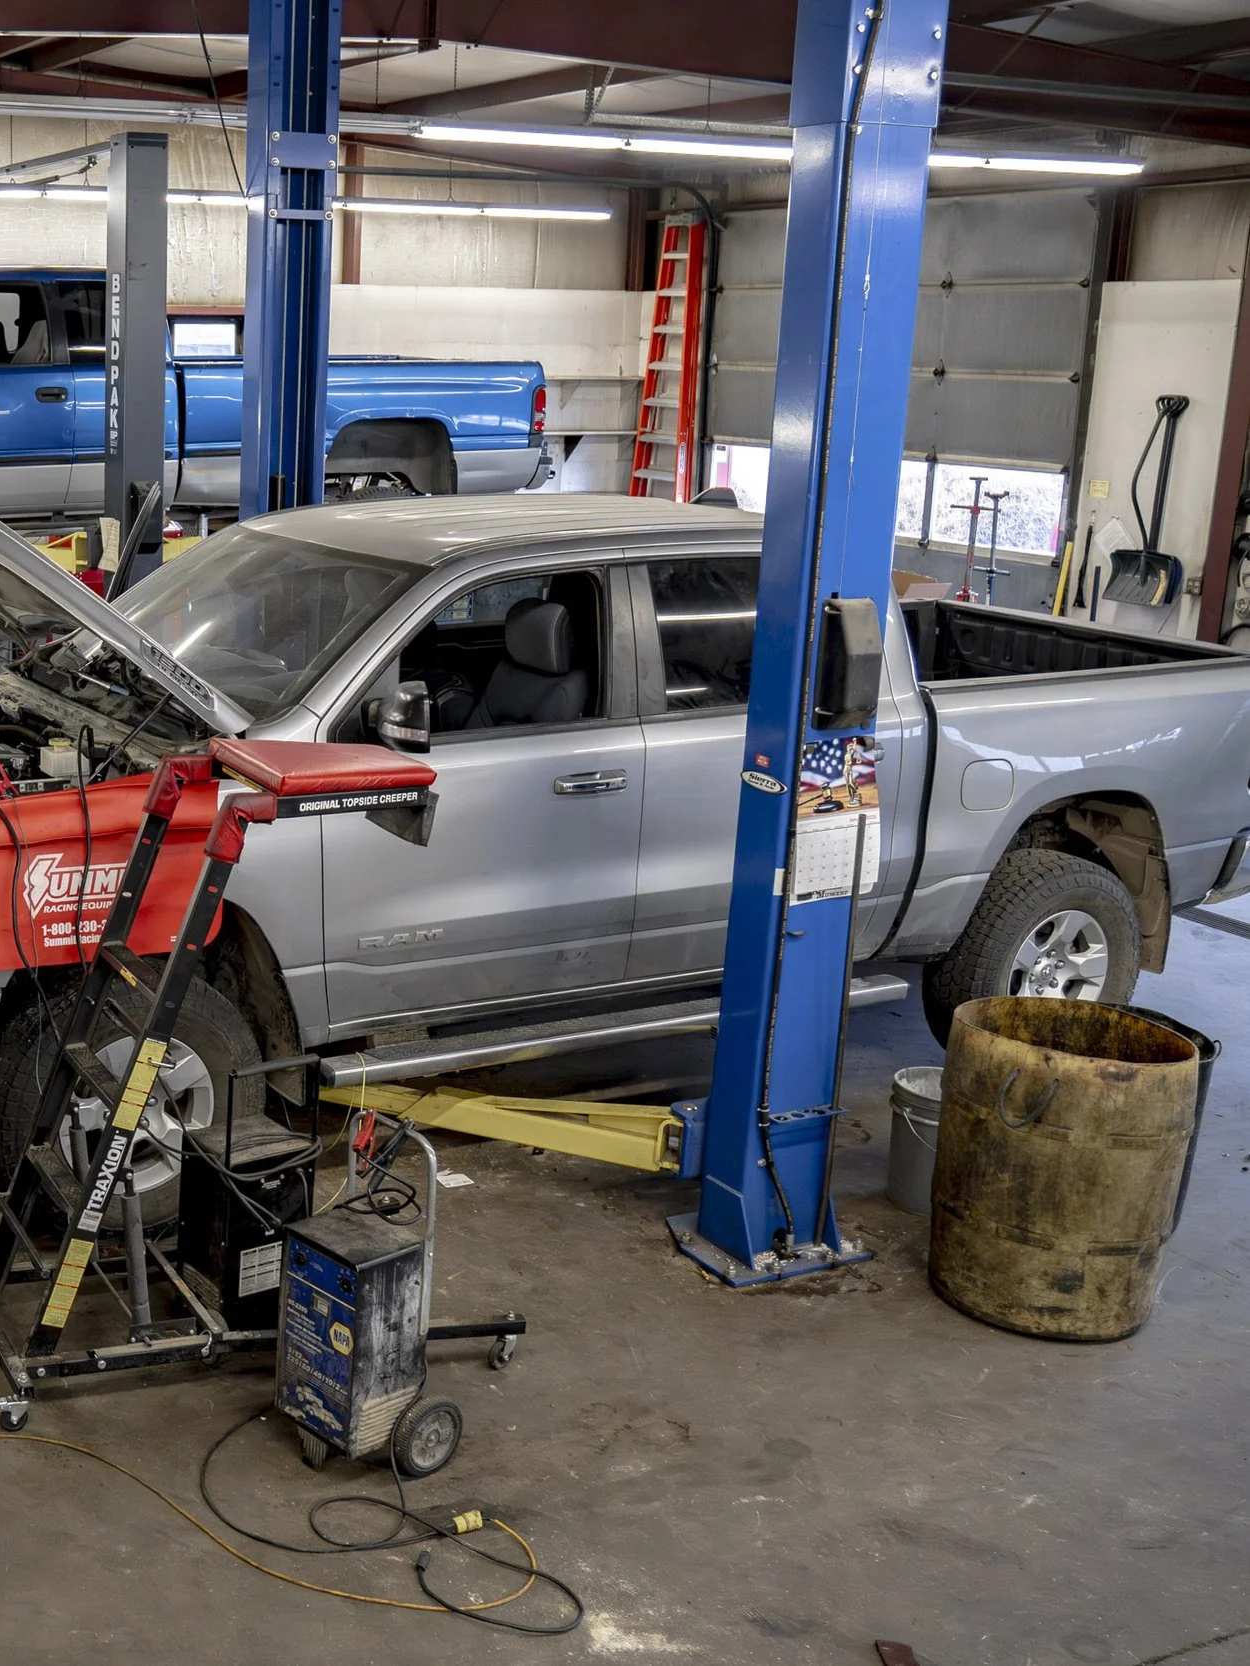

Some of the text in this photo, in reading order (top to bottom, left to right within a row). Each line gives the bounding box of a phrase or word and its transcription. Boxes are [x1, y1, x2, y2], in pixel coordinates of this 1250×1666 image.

[110, 273, 120, 429] BENDPAK
[299, 791, 418, 812] ORIGINAL TOPSIDE CREEPER
[82, 901, 113, 910] EQUIP
[41, 919, 107, 936] 1-800-230-
[356, 928, 444, 951] RAM
[86, 1134, 128, 1210] TRAXION
[333, 1328, 350, 1350] NAPA
